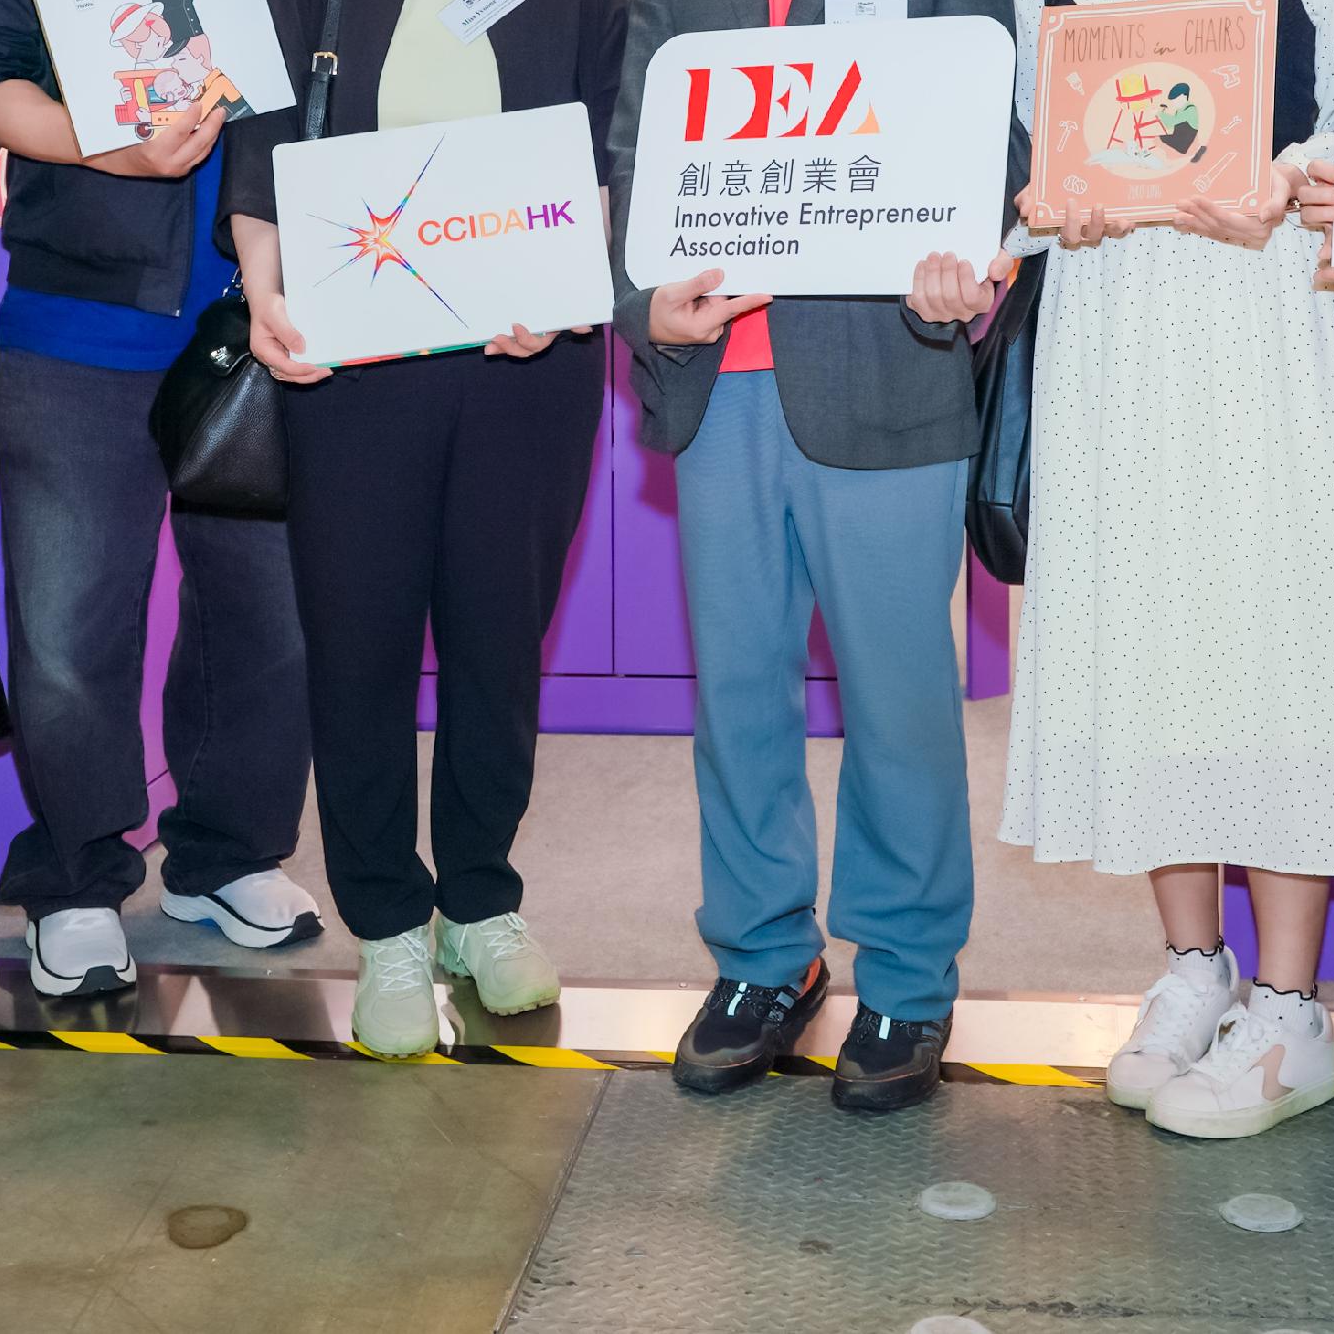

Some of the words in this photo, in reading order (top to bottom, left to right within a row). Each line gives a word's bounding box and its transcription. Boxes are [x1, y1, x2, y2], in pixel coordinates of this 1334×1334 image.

[1063, 24, 1146, 63] MOMENTS
[1153, 42, 1176, 56] in
[1184, 16, 1245, 55] CHAIRS
[677, 154, 882, 197] 創意創業會
[417, 200, 575, 246] CCIDAHK
[674, 204, 789, 228] Innovative
[799, 202, 957, 230] Entrepreneur
[670, 234, 799, 257] Association
